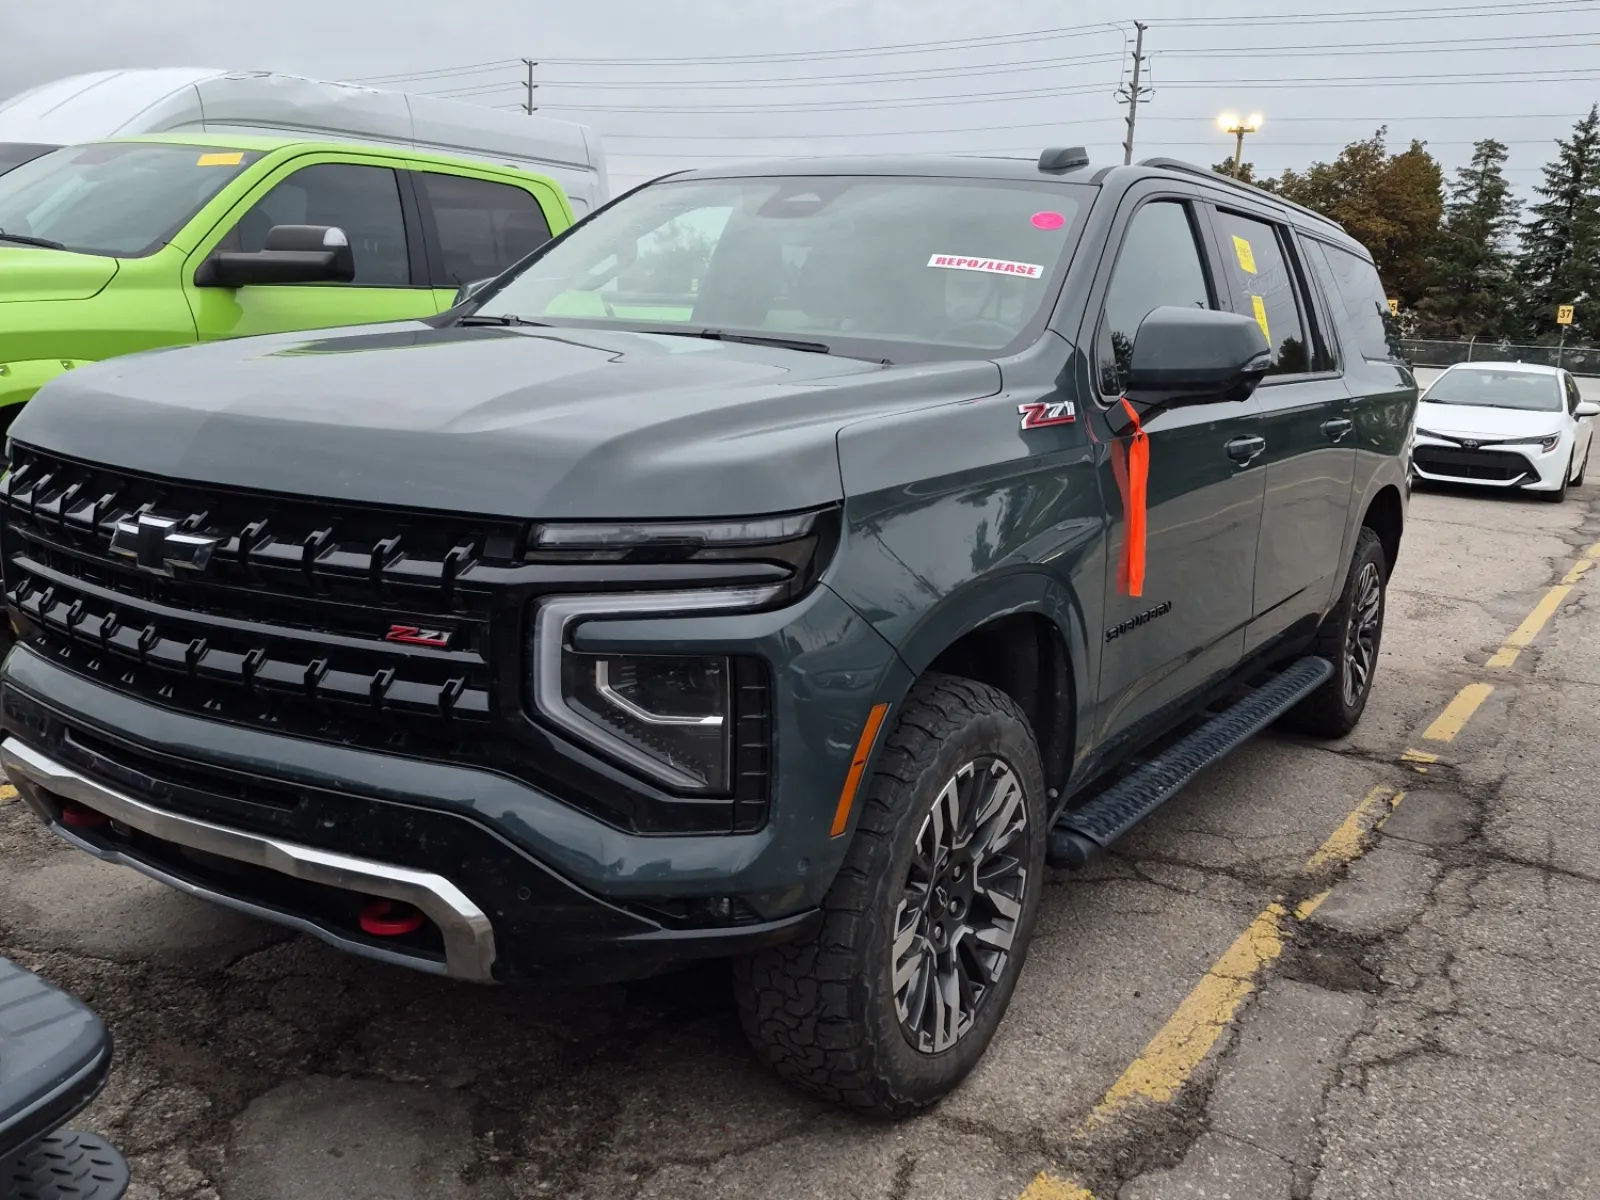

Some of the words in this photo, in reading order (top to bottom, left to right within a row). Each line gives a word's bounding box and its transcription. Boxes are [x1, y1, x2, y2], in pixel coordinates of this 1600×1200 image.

[935, 257, 1037, 275] REPO/LEASE
[1559, 308, 1571, 318] 37
[1018, 401, 1076, 429] Z71
[386, 624, 452, 646] Z71
